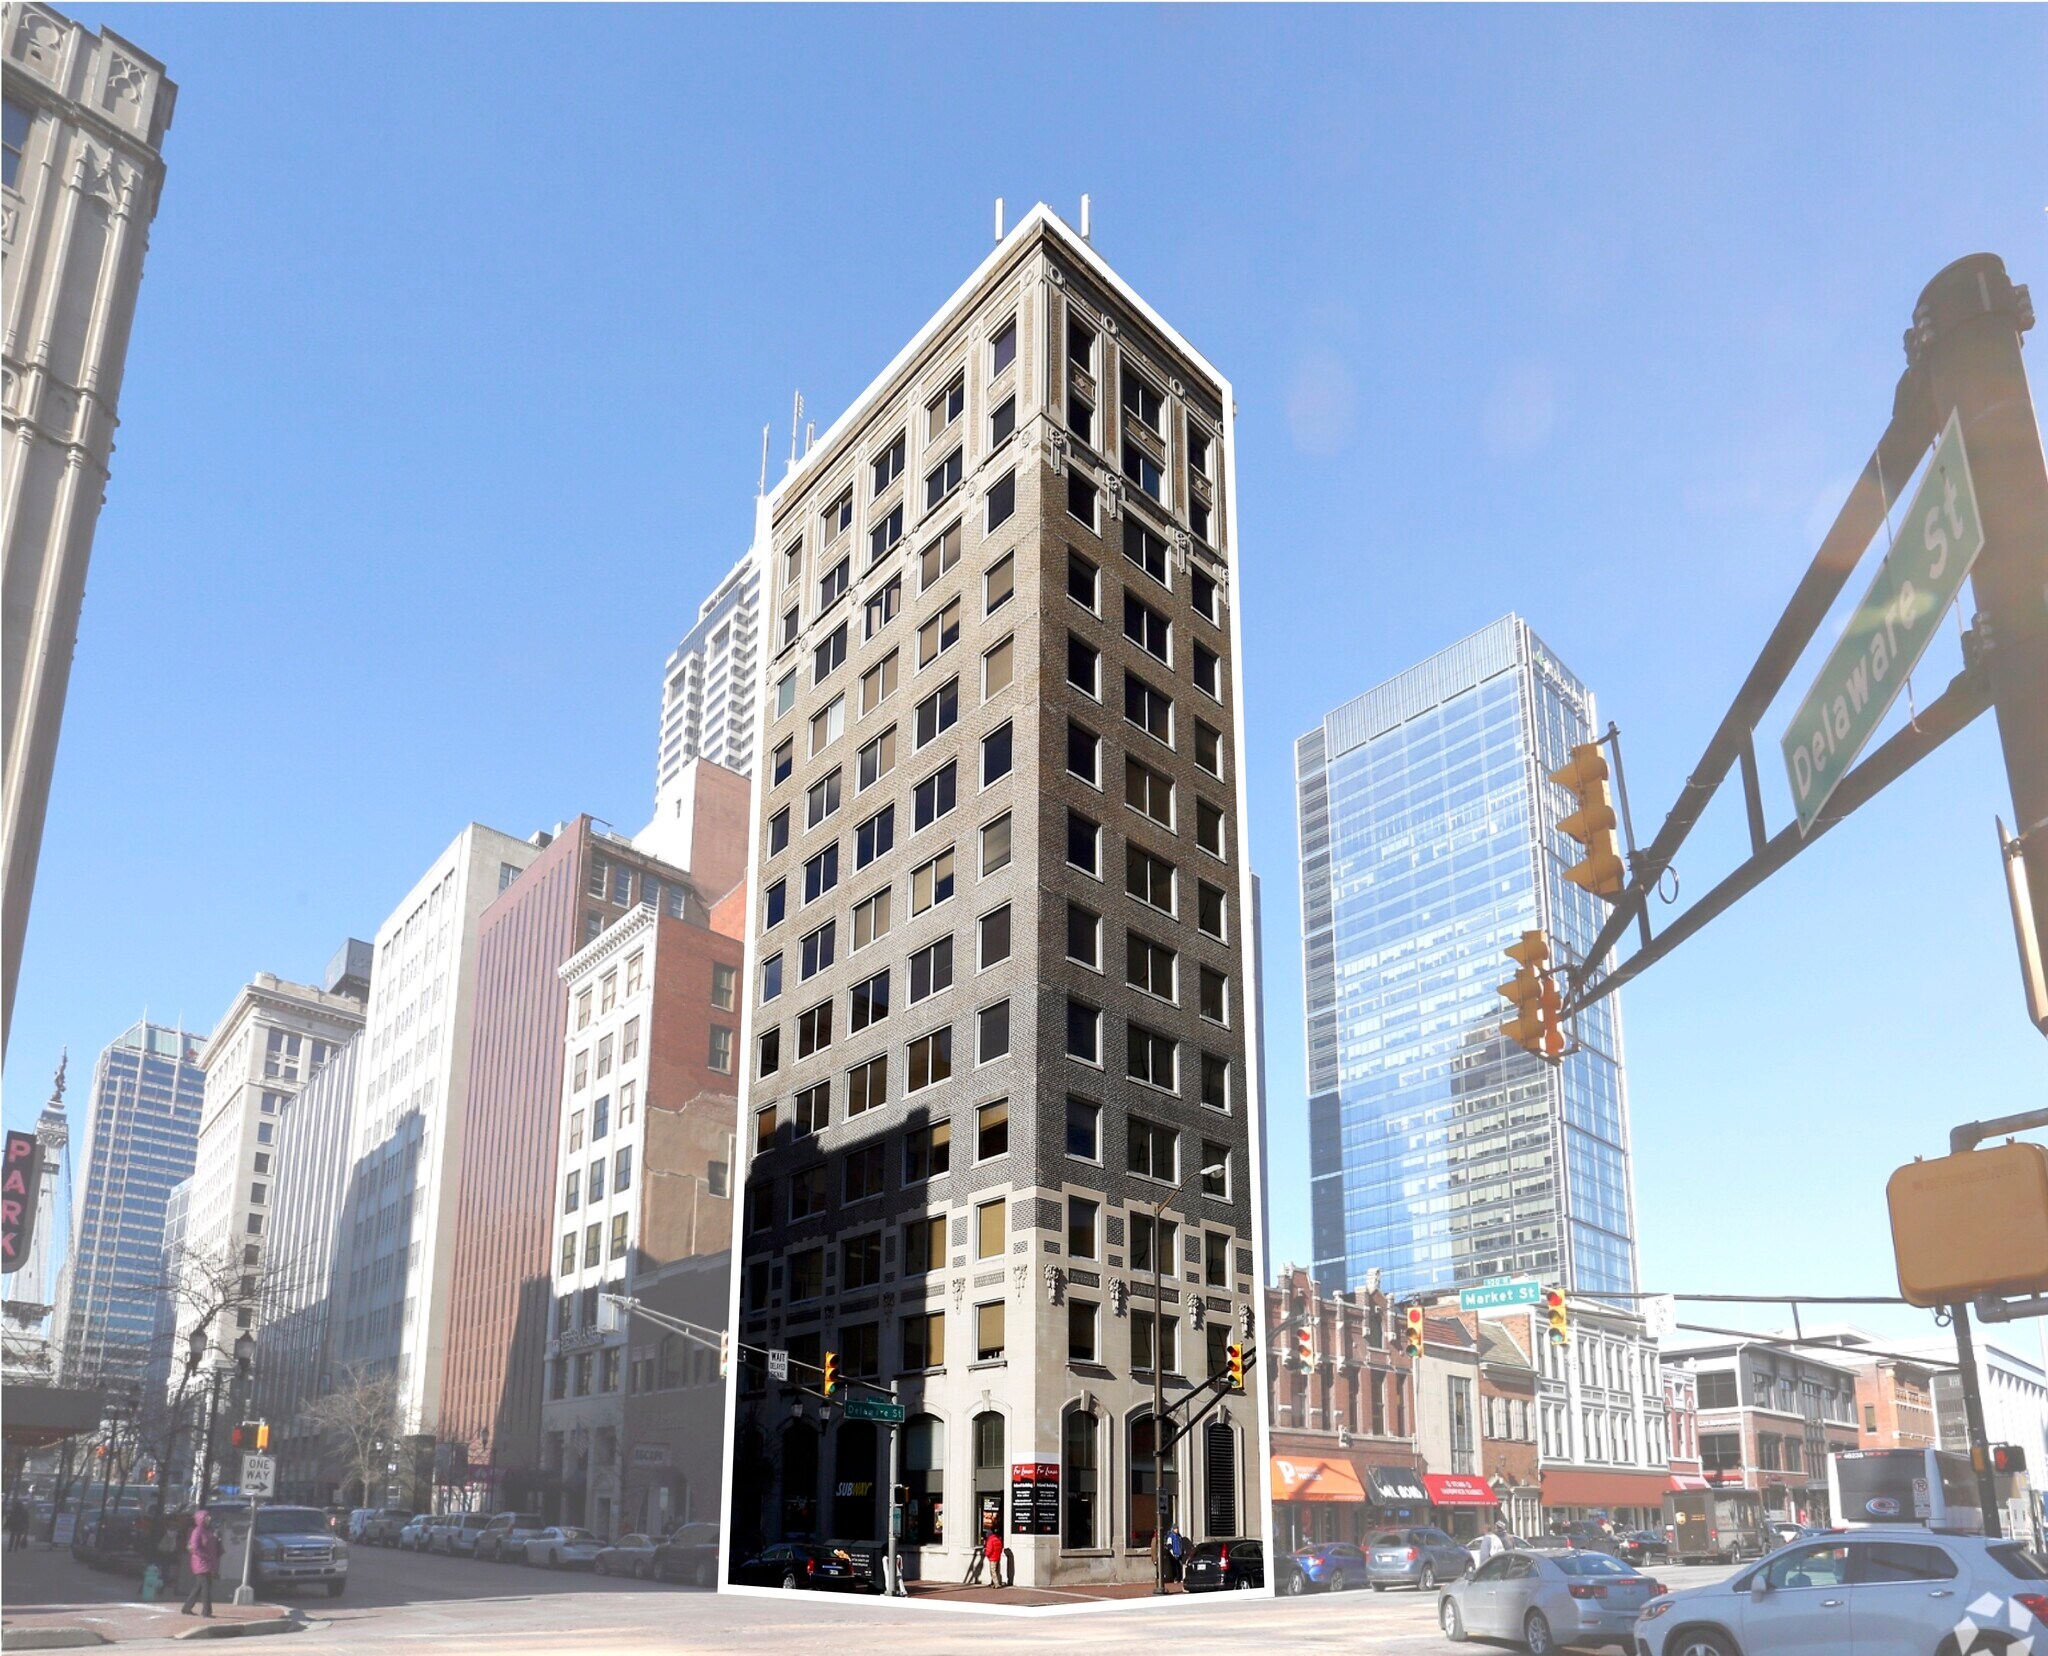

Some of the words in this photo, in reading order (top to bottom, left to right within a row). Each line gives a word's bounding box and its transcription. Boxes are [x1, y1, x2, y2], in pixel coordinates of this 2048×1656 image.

[1793, 579, 1917, 801] Delaware
[1923, 476, 1965, 580] St
[2, 1139, 31, 1257] PARK
[1465, 1289, 1514, 1306] Market
[1518, 1287, 1535, 1300] St
[848, 1404, 889, 1417] Delaware
[892, 1408, 902, 1419] St
[249, 1459, 270, 1469] ONE
[246, 1470, 270, 1480] WAY
[835, 1482, 873, 1497] SUBWAY
